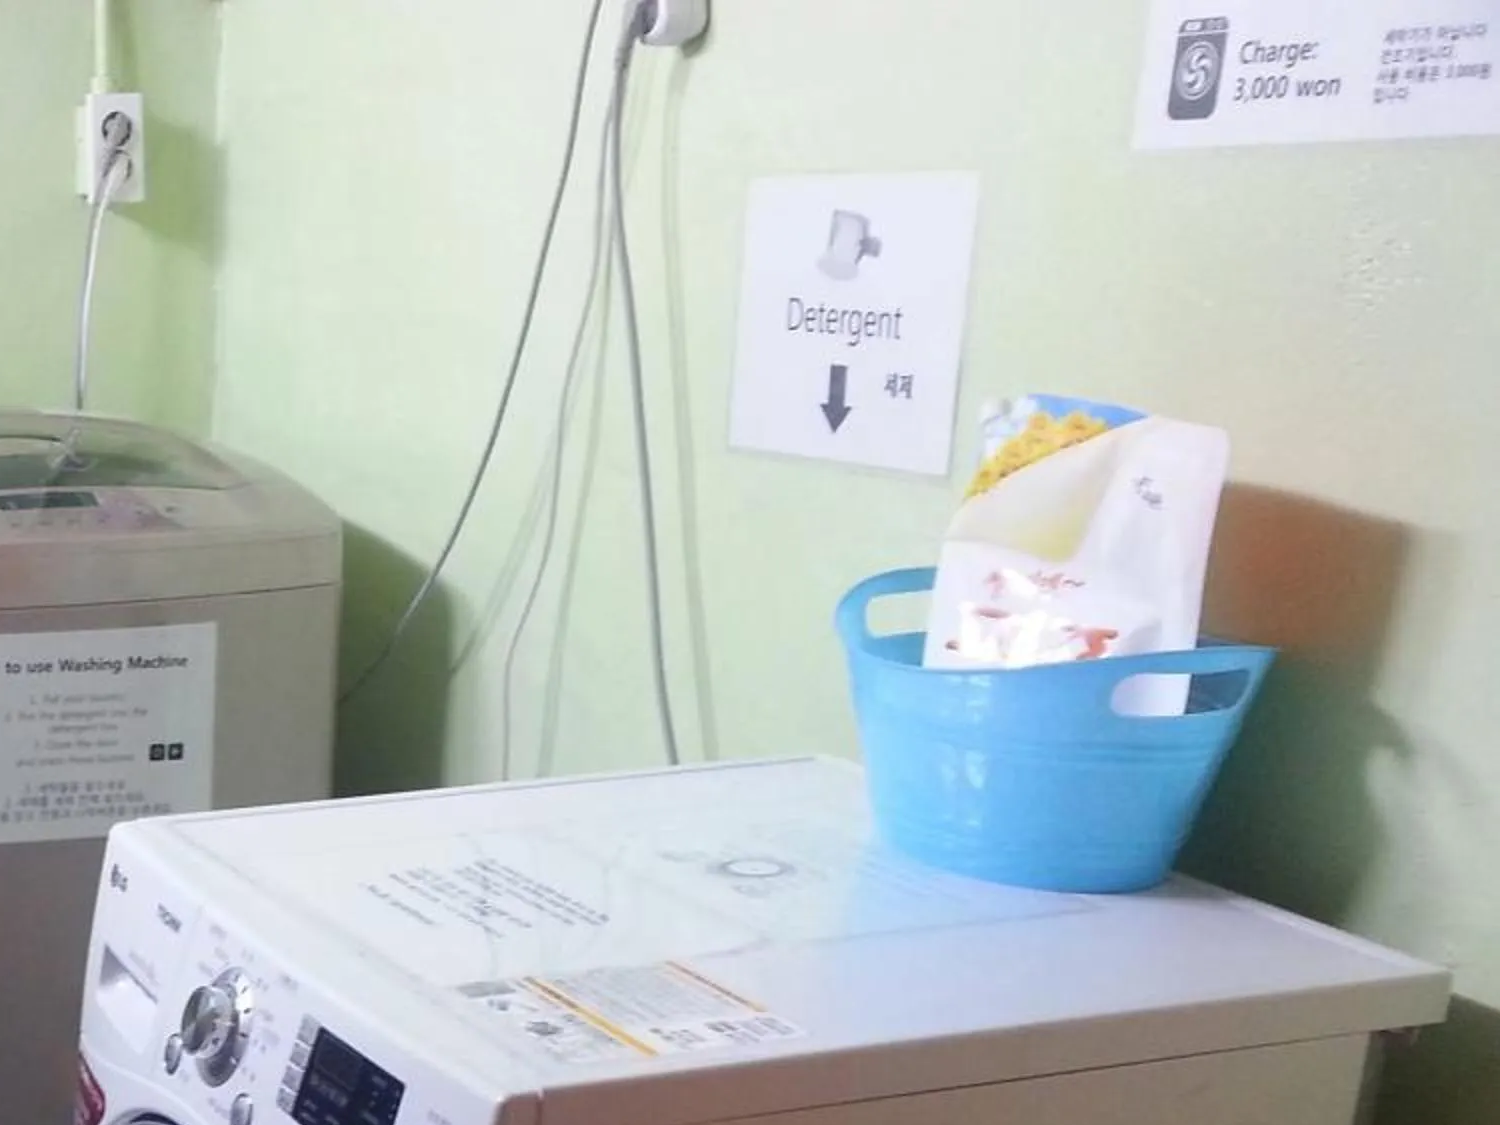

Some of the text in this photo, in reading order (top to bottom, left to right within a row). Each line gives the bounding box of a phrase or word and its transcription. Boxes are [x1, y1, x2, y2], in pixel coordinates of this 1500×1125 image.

[1240, 40, 1320, 69] Charge:
[1233, 75, 1342, 104] 3,000 won
[786, 297, 904, 347] Detergent
[4, 661, 21, 674] to
[26, 662, 53, 674] use
[57, 657, 123, 675] Washing
[127, 655, 189, 670] Machine
